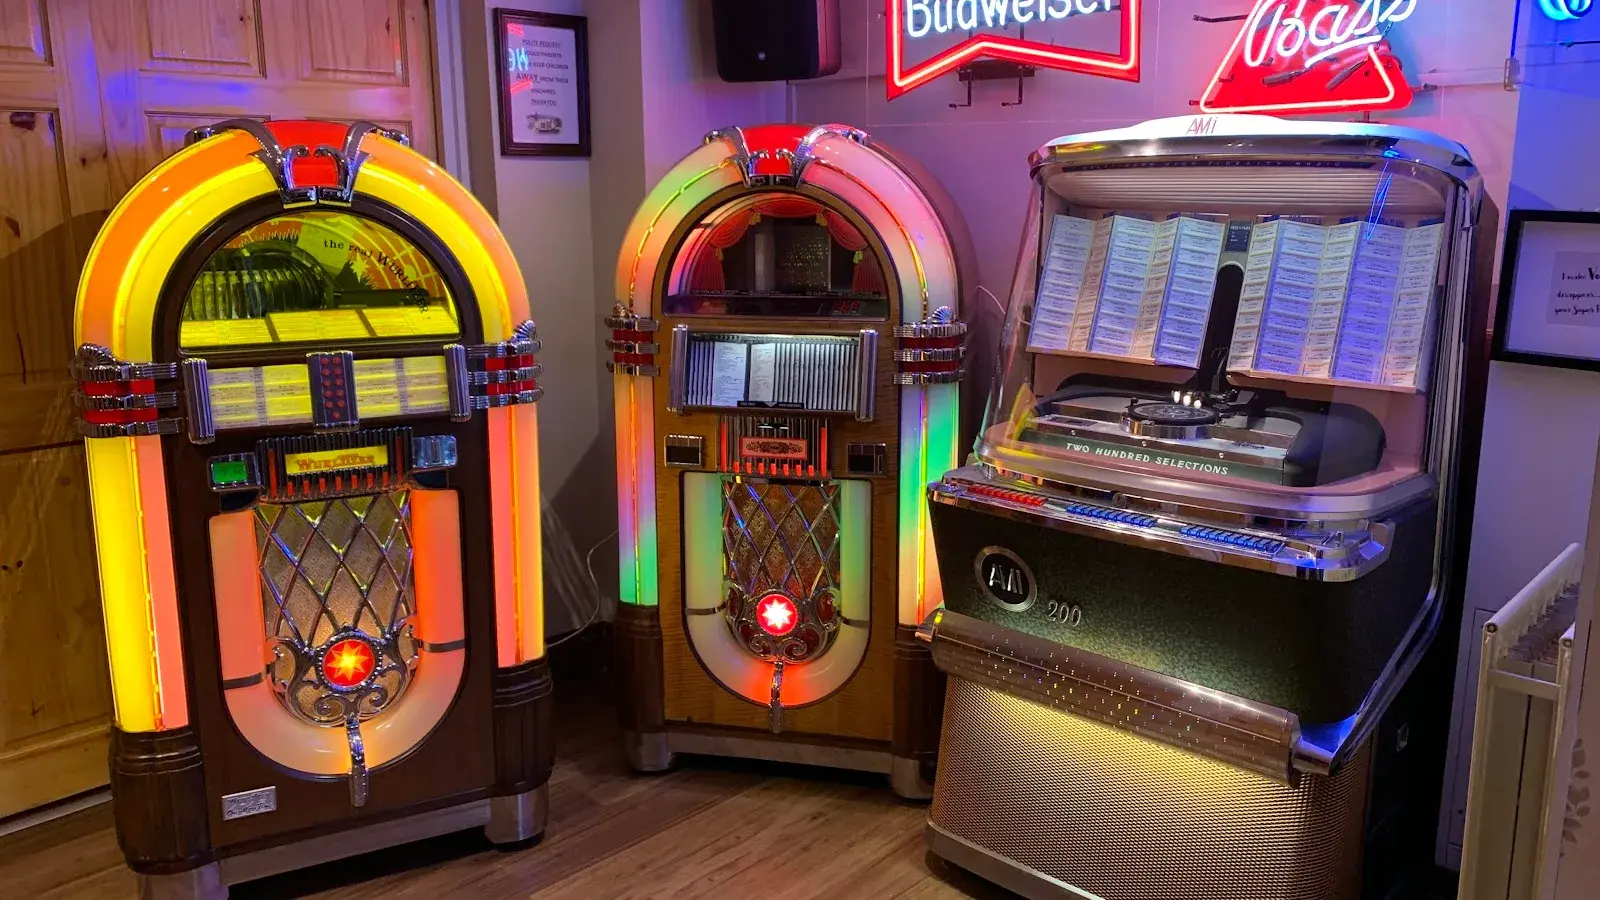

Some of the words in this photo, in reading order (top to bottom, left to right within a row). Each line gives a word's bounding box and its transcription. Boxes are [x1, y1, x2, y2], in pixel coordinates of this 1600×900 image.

[906, 0, 1112, 38] Budweis
[516, 72, 539, 82] AWAY
[323, 239, 345, 250] the
[348, 244, 373, 259] real
[1065, 442, 1090, 454] TWO
[1095, 447, 1151, 463] HUNDRED
[1155, 456, 1229, 476] SELECTIONS
[1046, 600, 1082, 627] 200
